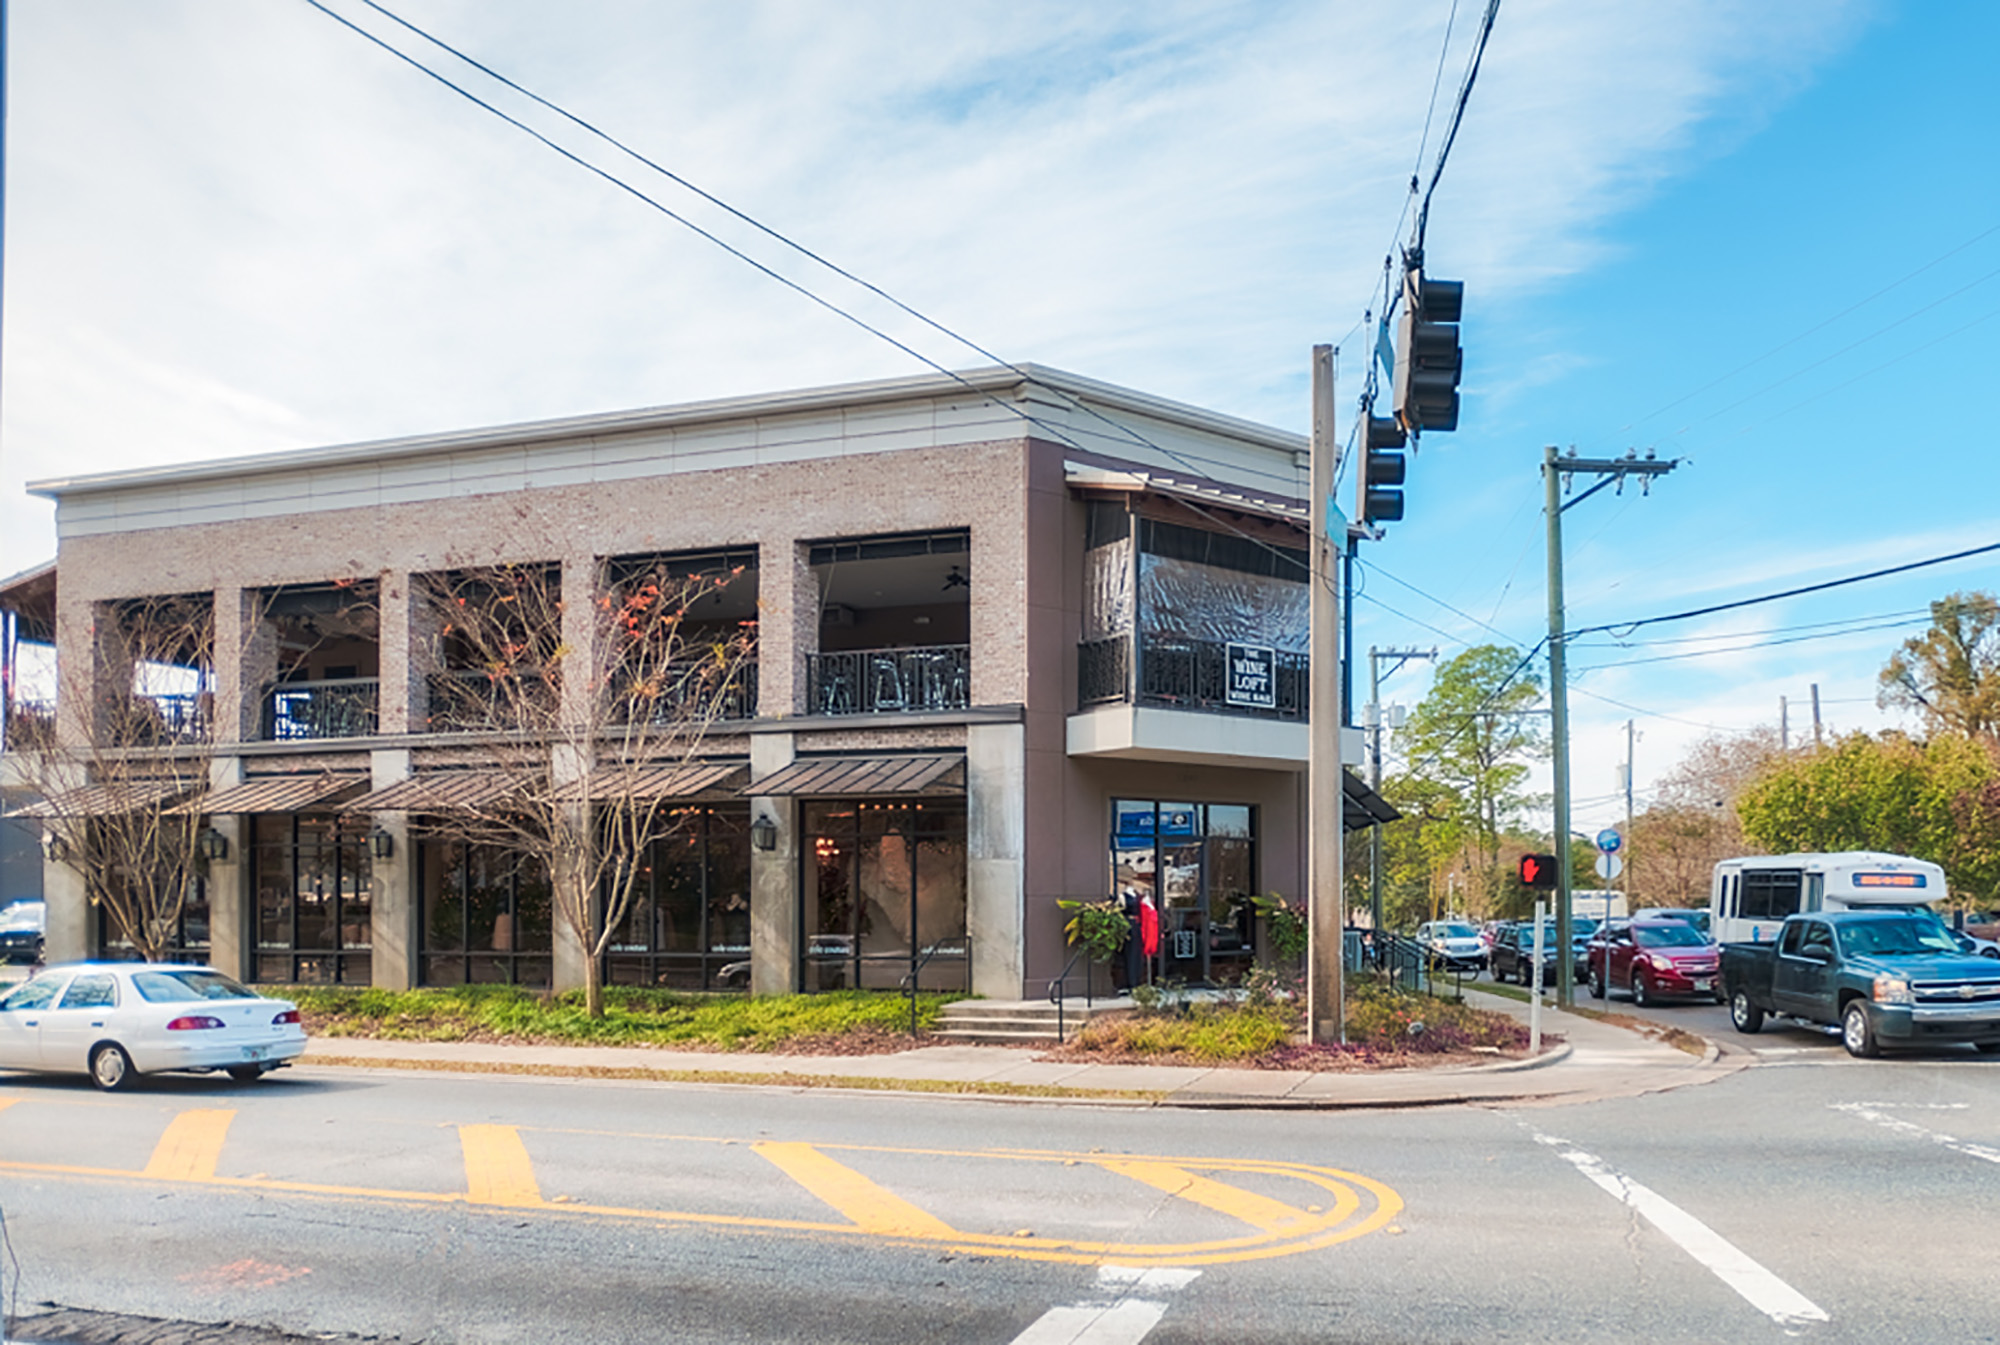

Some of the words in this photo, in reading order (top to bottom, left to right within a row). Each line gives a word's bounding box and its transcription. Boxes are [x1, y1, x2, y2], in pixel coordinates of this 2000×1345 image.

[1244, 648, 1259, 659] THE
[1233, 659, 1267, 676] WINE
[1235, 675, 1268, 691] LOFT
[1230, 690, 1251, 701] WINE
